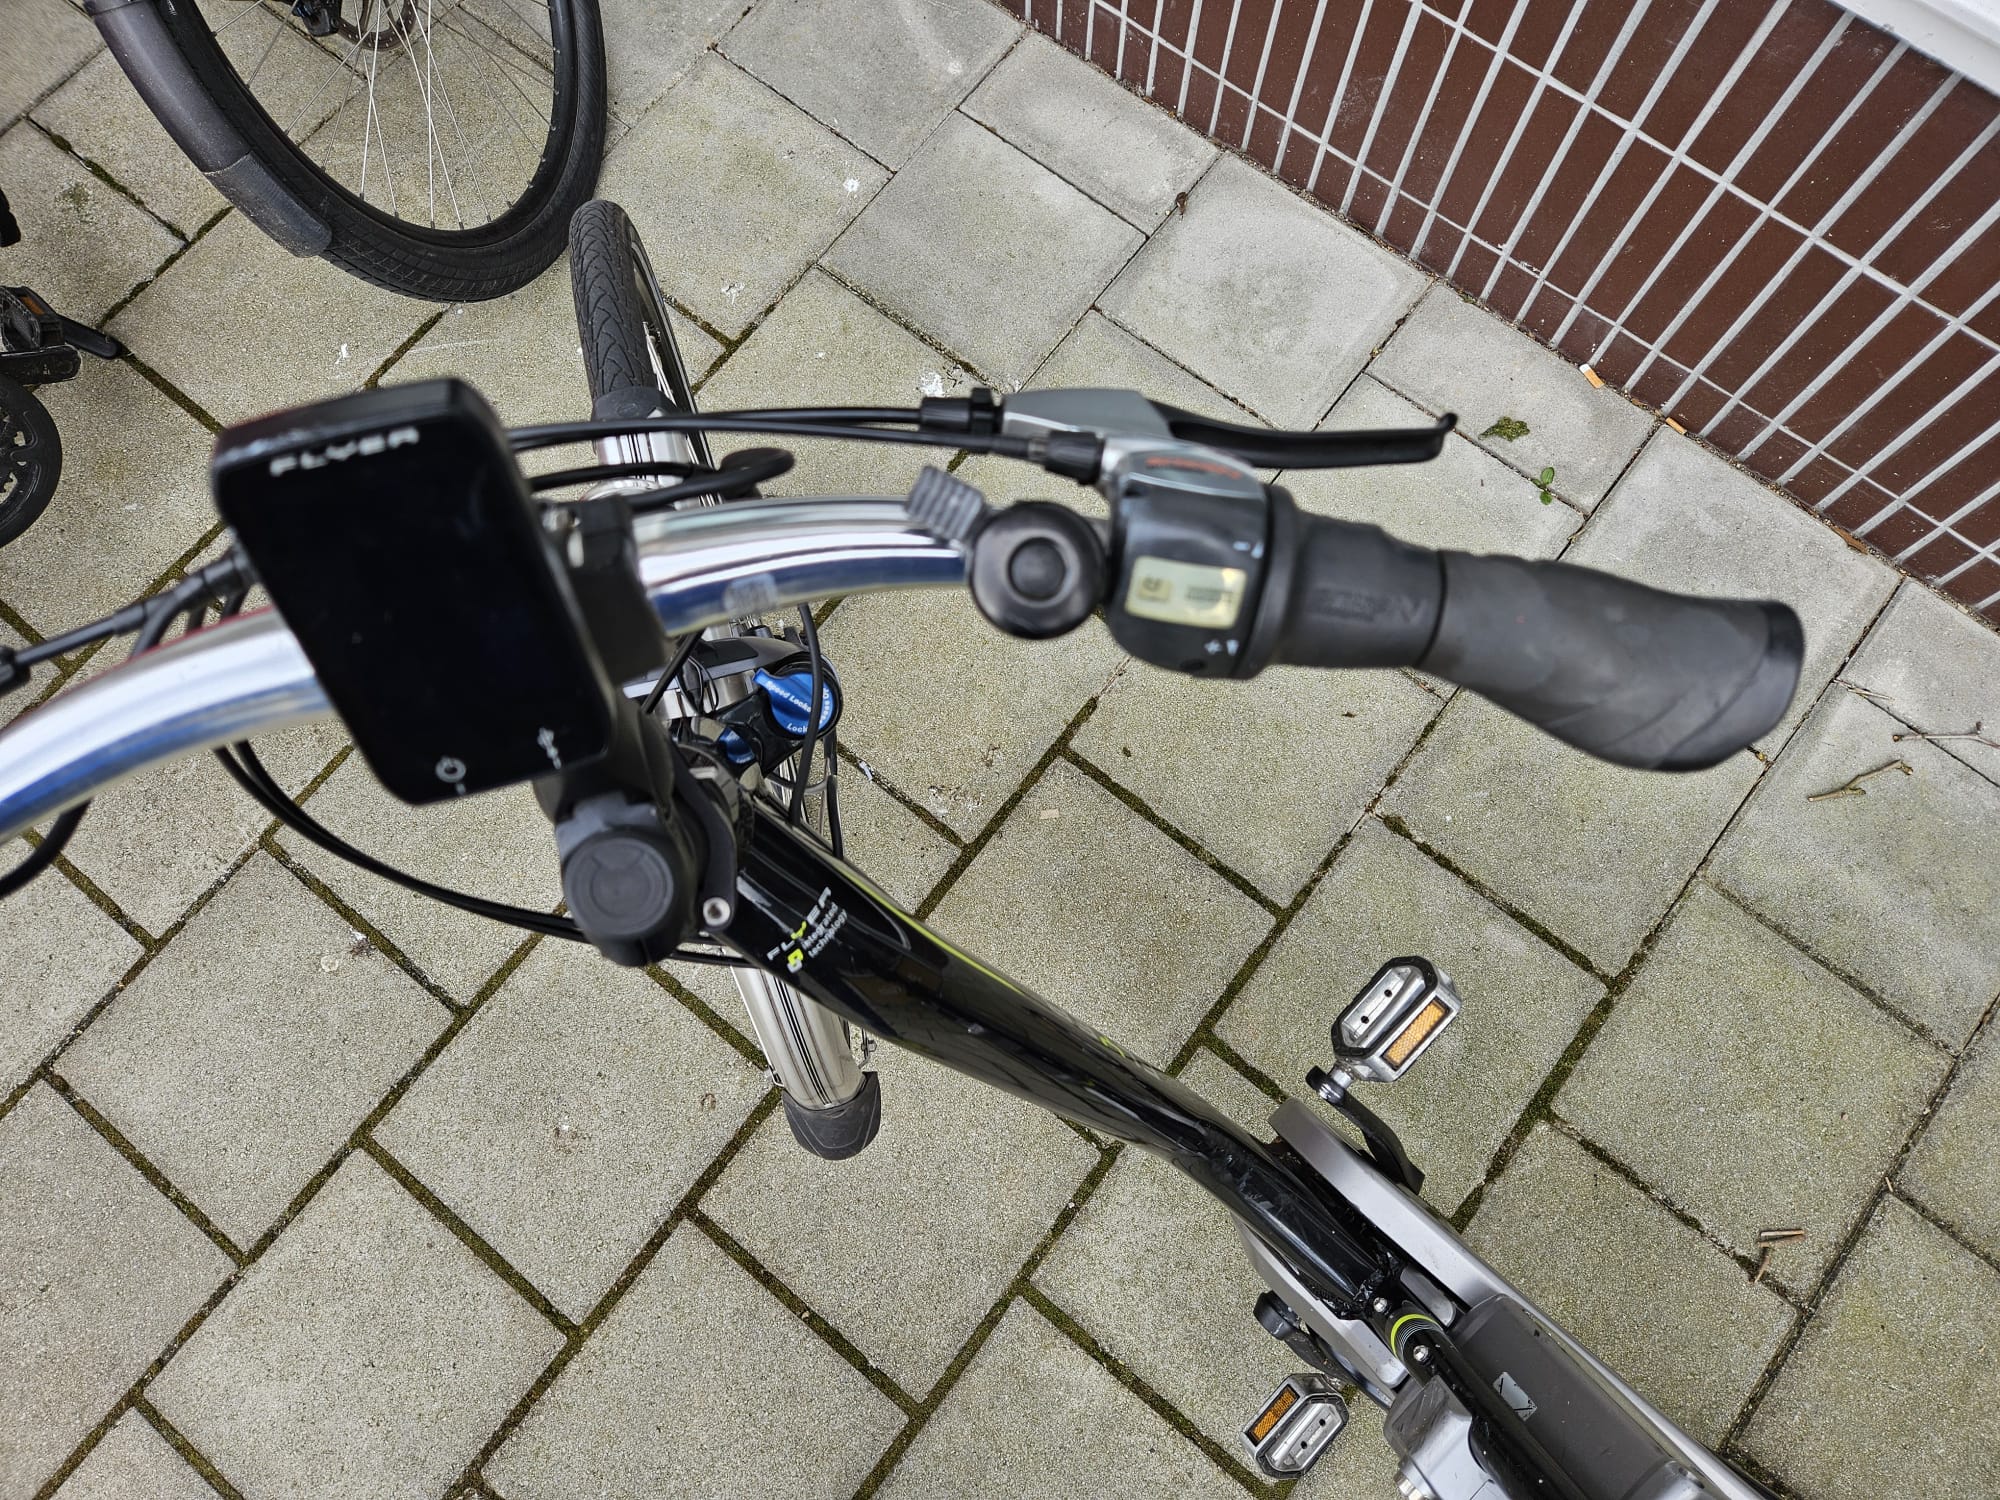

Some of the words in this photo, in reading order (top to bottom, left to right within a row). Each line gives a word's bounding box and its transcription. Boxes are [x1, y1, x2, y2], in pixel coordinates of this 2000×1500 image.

[270, 426, 420, 476] FLYER
[767, 681, 791, 698] Speed
[766, 886, 832, 961] FLYER
[800, 902, 839, 950] integrated
[808, 909, 848, 958] technology
